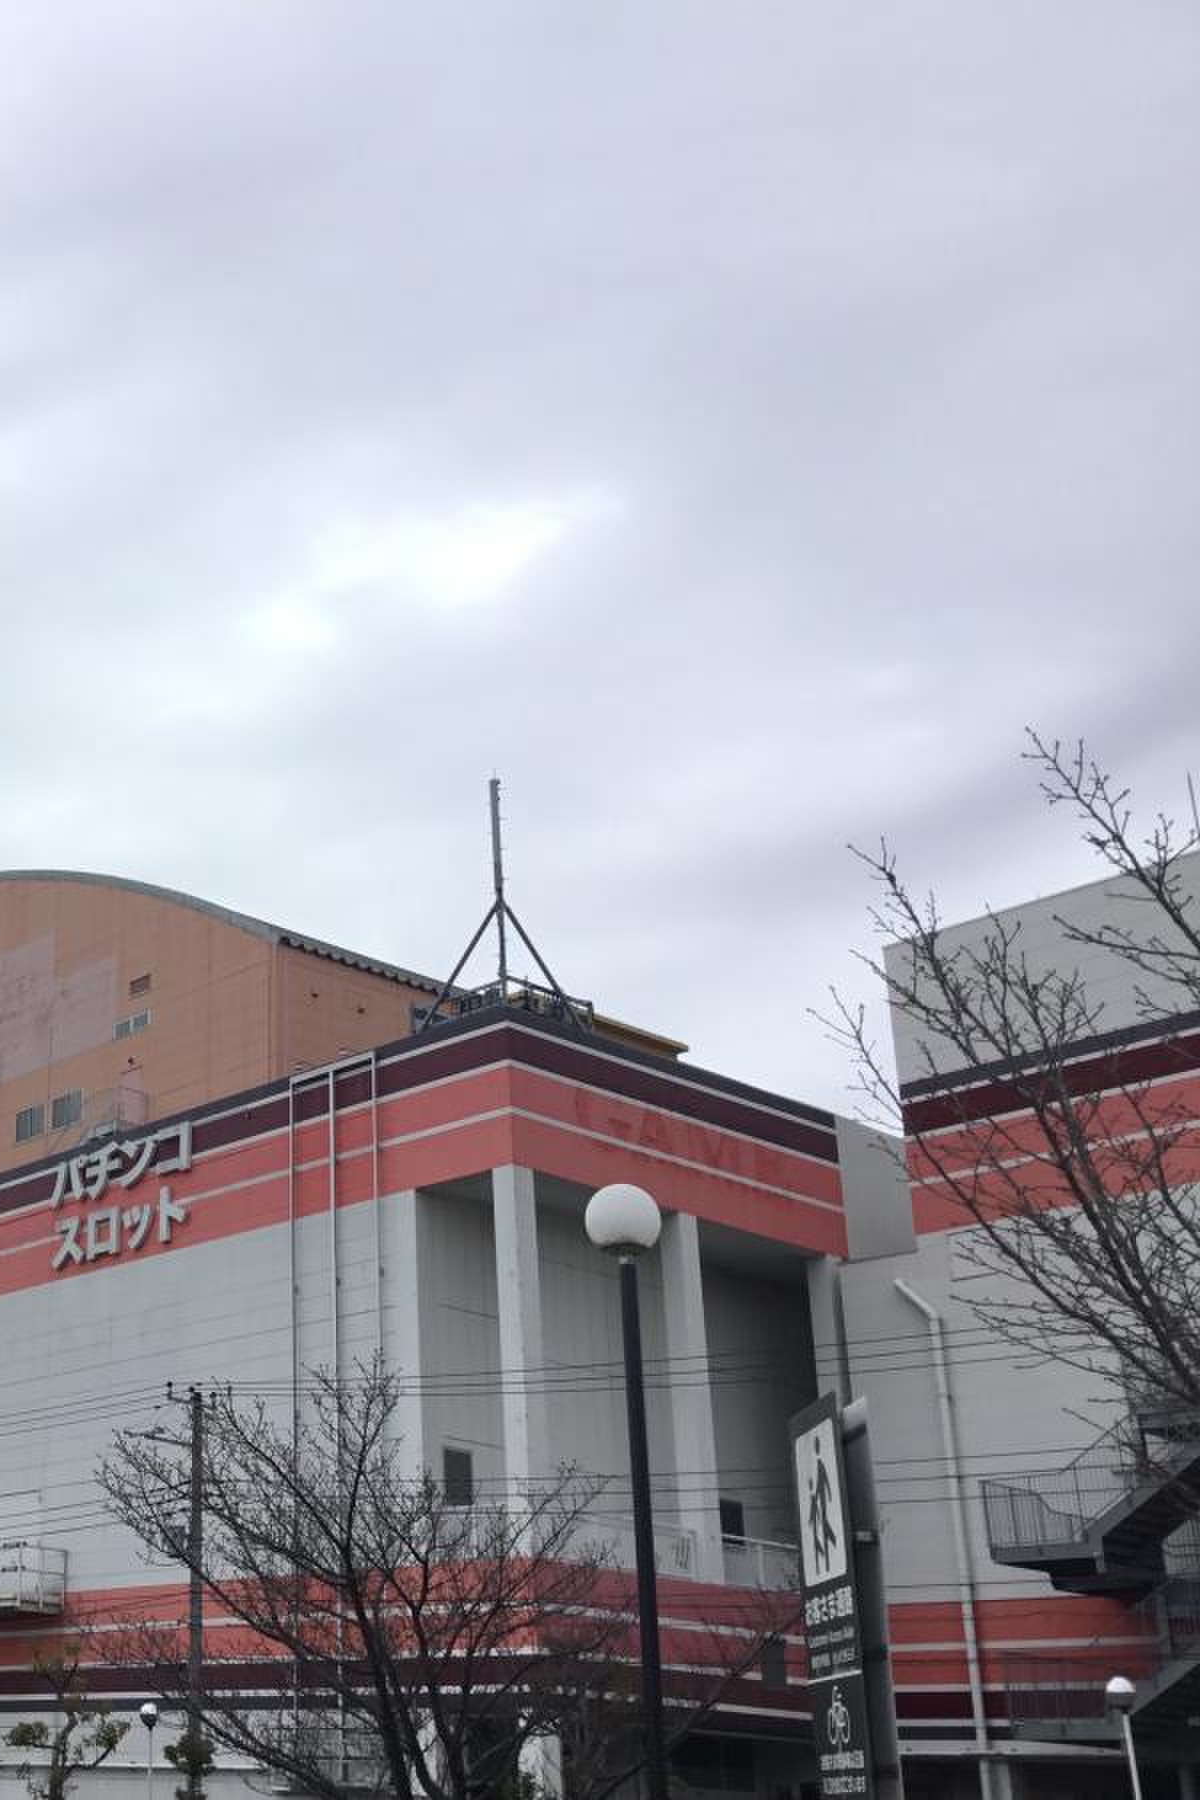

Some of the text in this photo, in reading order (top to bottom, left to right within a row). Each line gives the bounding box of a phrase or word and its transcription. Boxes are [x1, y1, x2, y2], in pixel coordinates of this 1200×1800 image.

[50, 1121, 193, 1209] パチンコ
[51, 1185, 189, 1270] スロット
